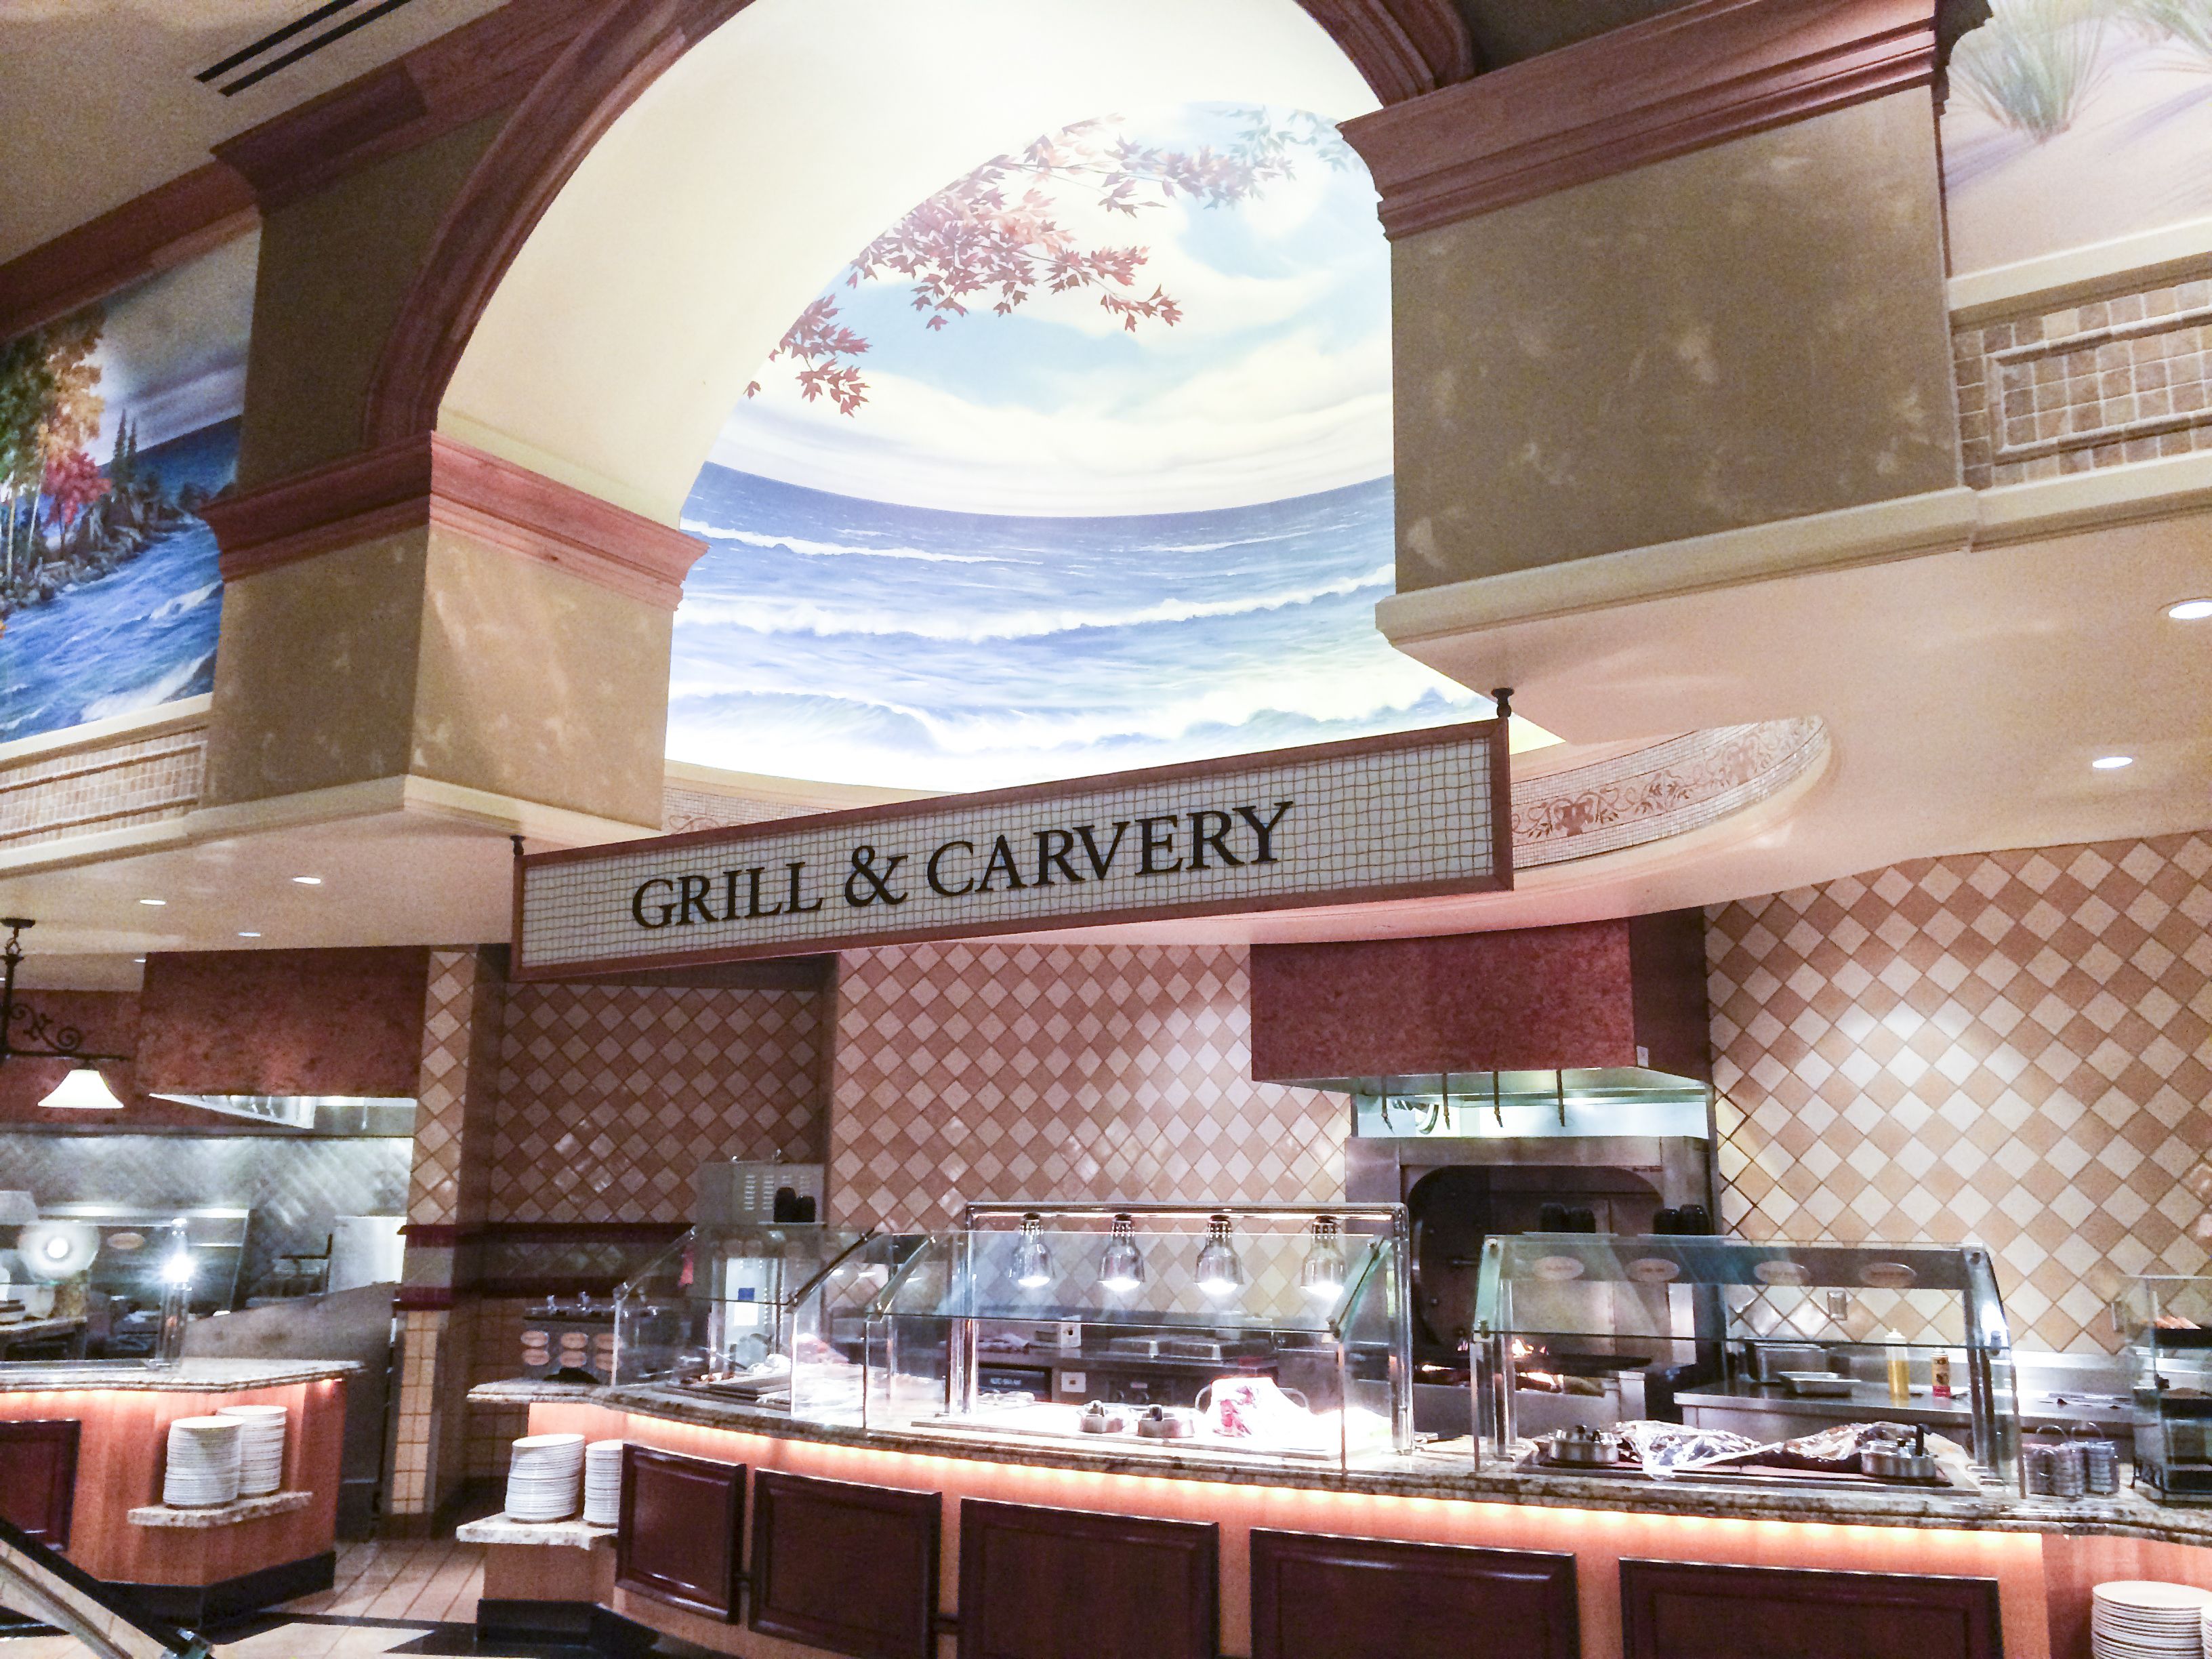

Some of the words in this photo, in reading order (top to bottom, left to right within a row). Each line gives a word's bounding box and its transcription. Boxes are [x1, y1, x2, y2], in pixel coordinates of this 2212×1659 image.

[632, 861, 825, 930] GRILL
[843, 845, 909, 908] &
[926, 800, 1294, 898] CARVERY
